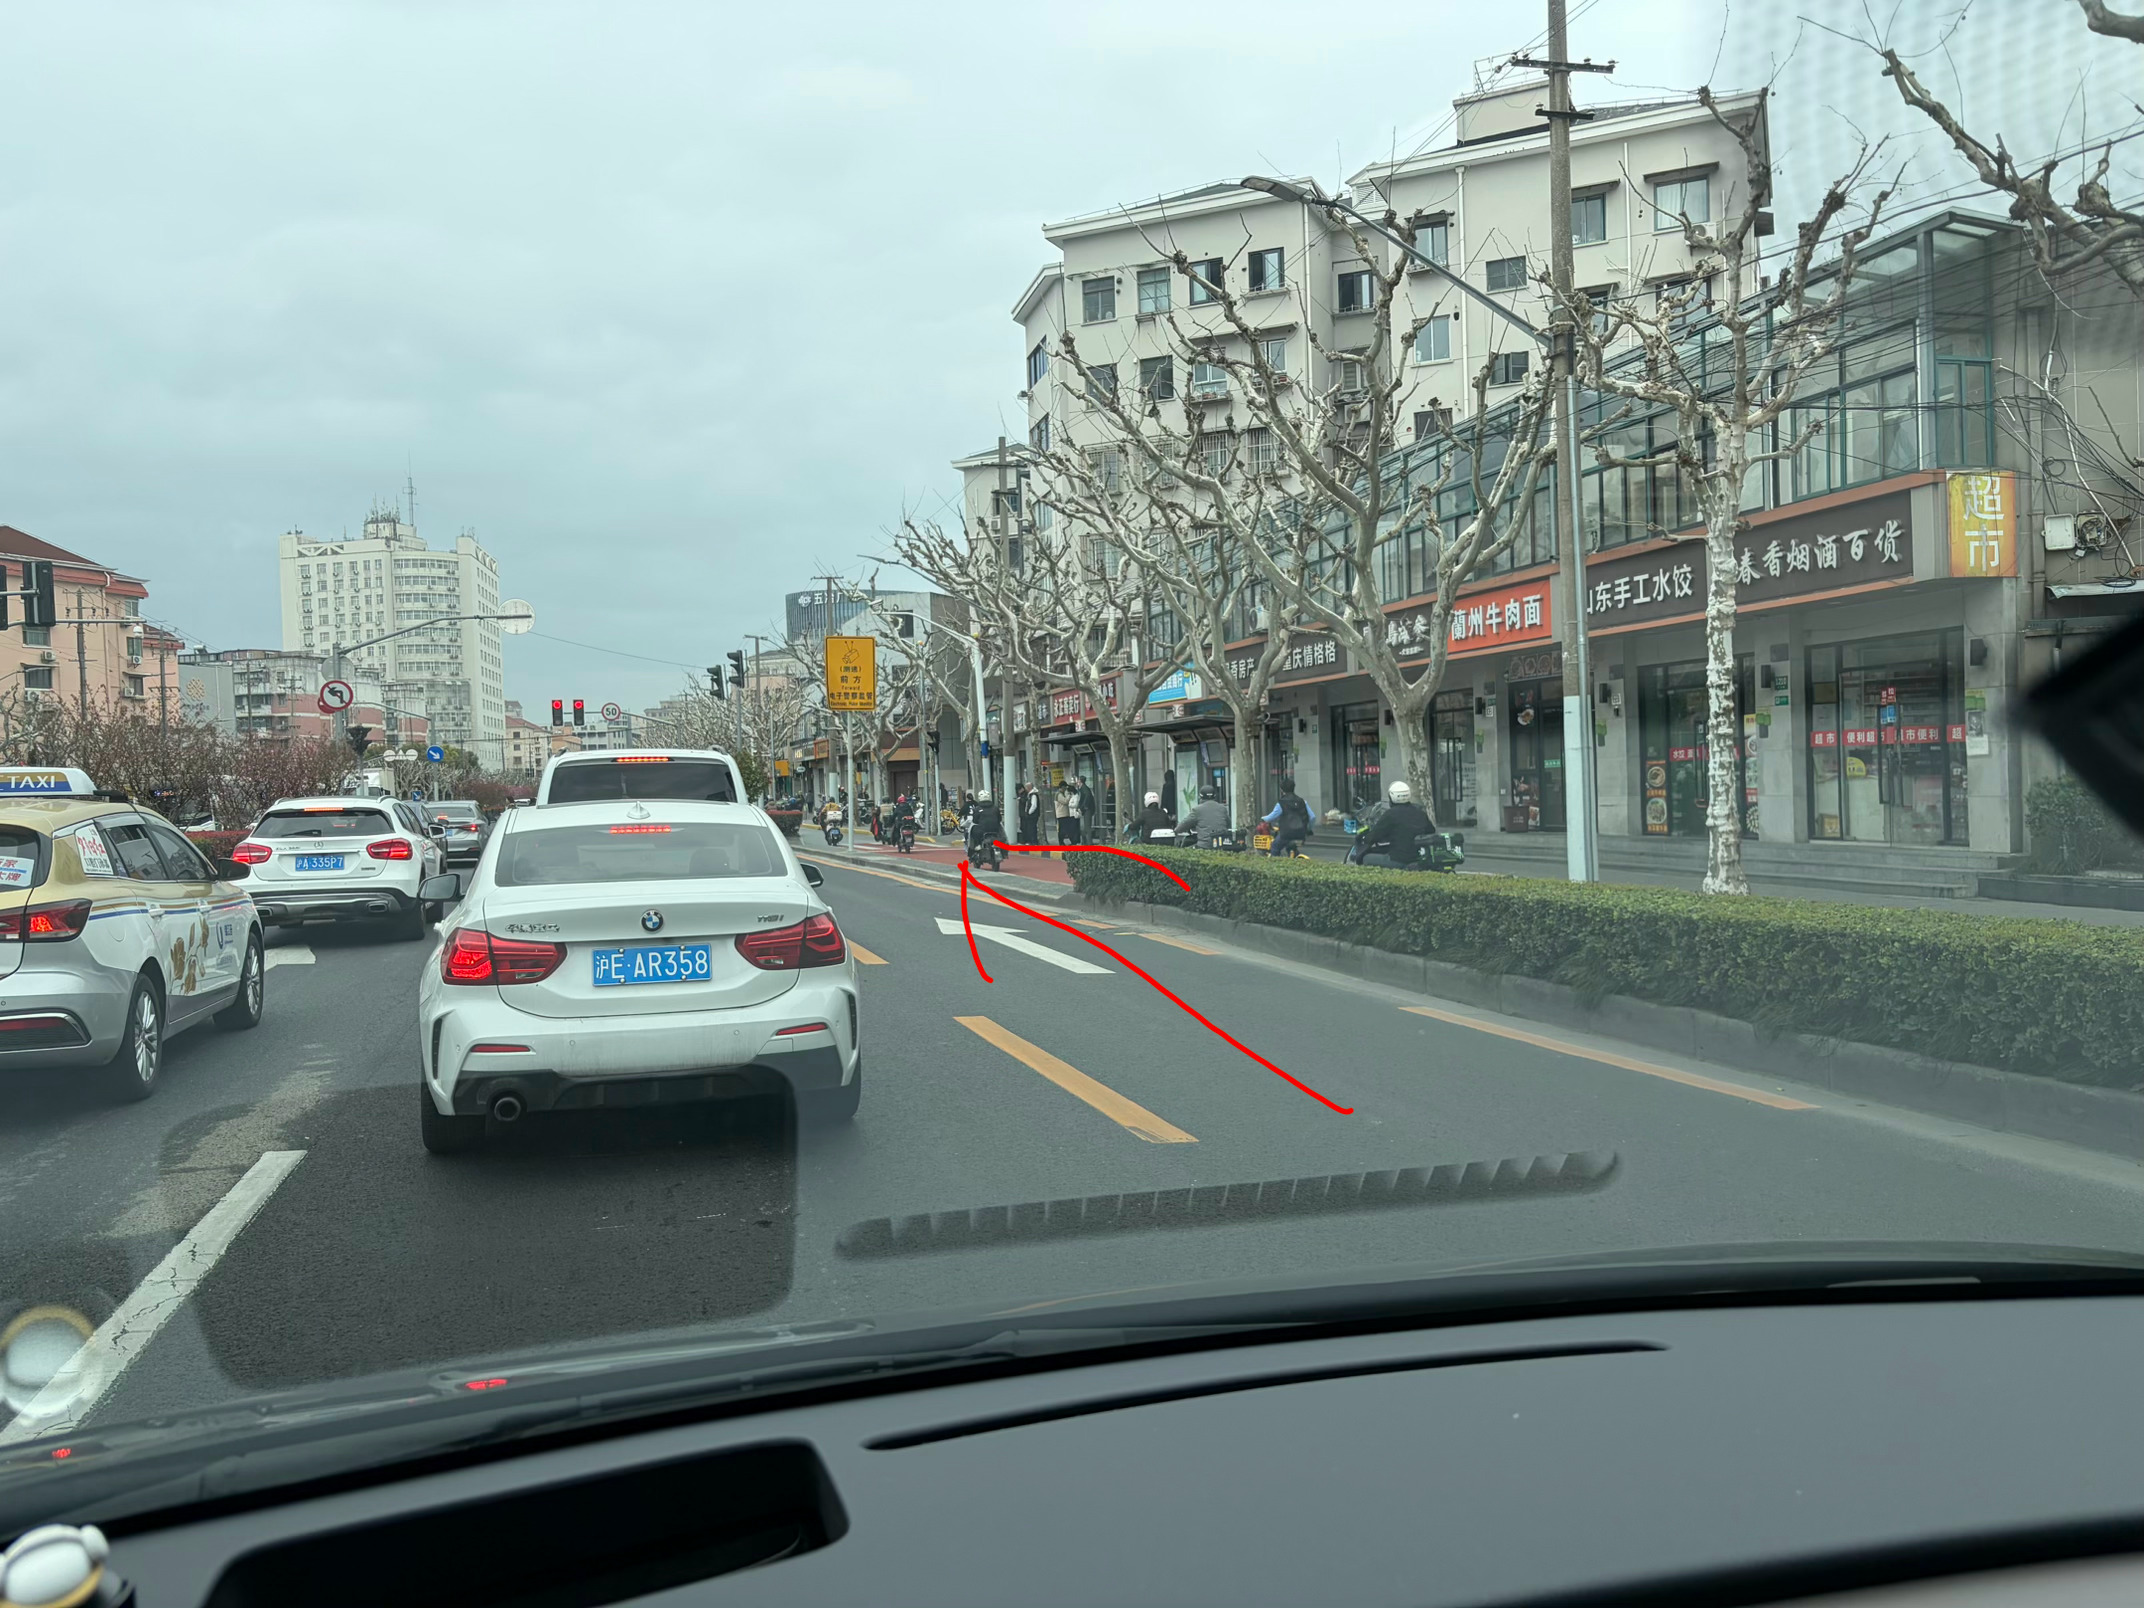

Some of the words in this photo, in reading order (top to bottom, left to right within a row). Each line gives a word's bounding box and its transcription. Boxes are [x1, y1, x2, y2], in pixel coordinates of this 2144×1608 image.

[1963, 475, 2004, 572] 超市
[1736, 519, 1903, 585] 春香烟酒百货
[605, 707, 617, 716] 50
[1815, 732, 1835, 745] 超市
[8, 775, 56, 789] TAXI
[595, 949, 709, 980] 沪E·AR358
